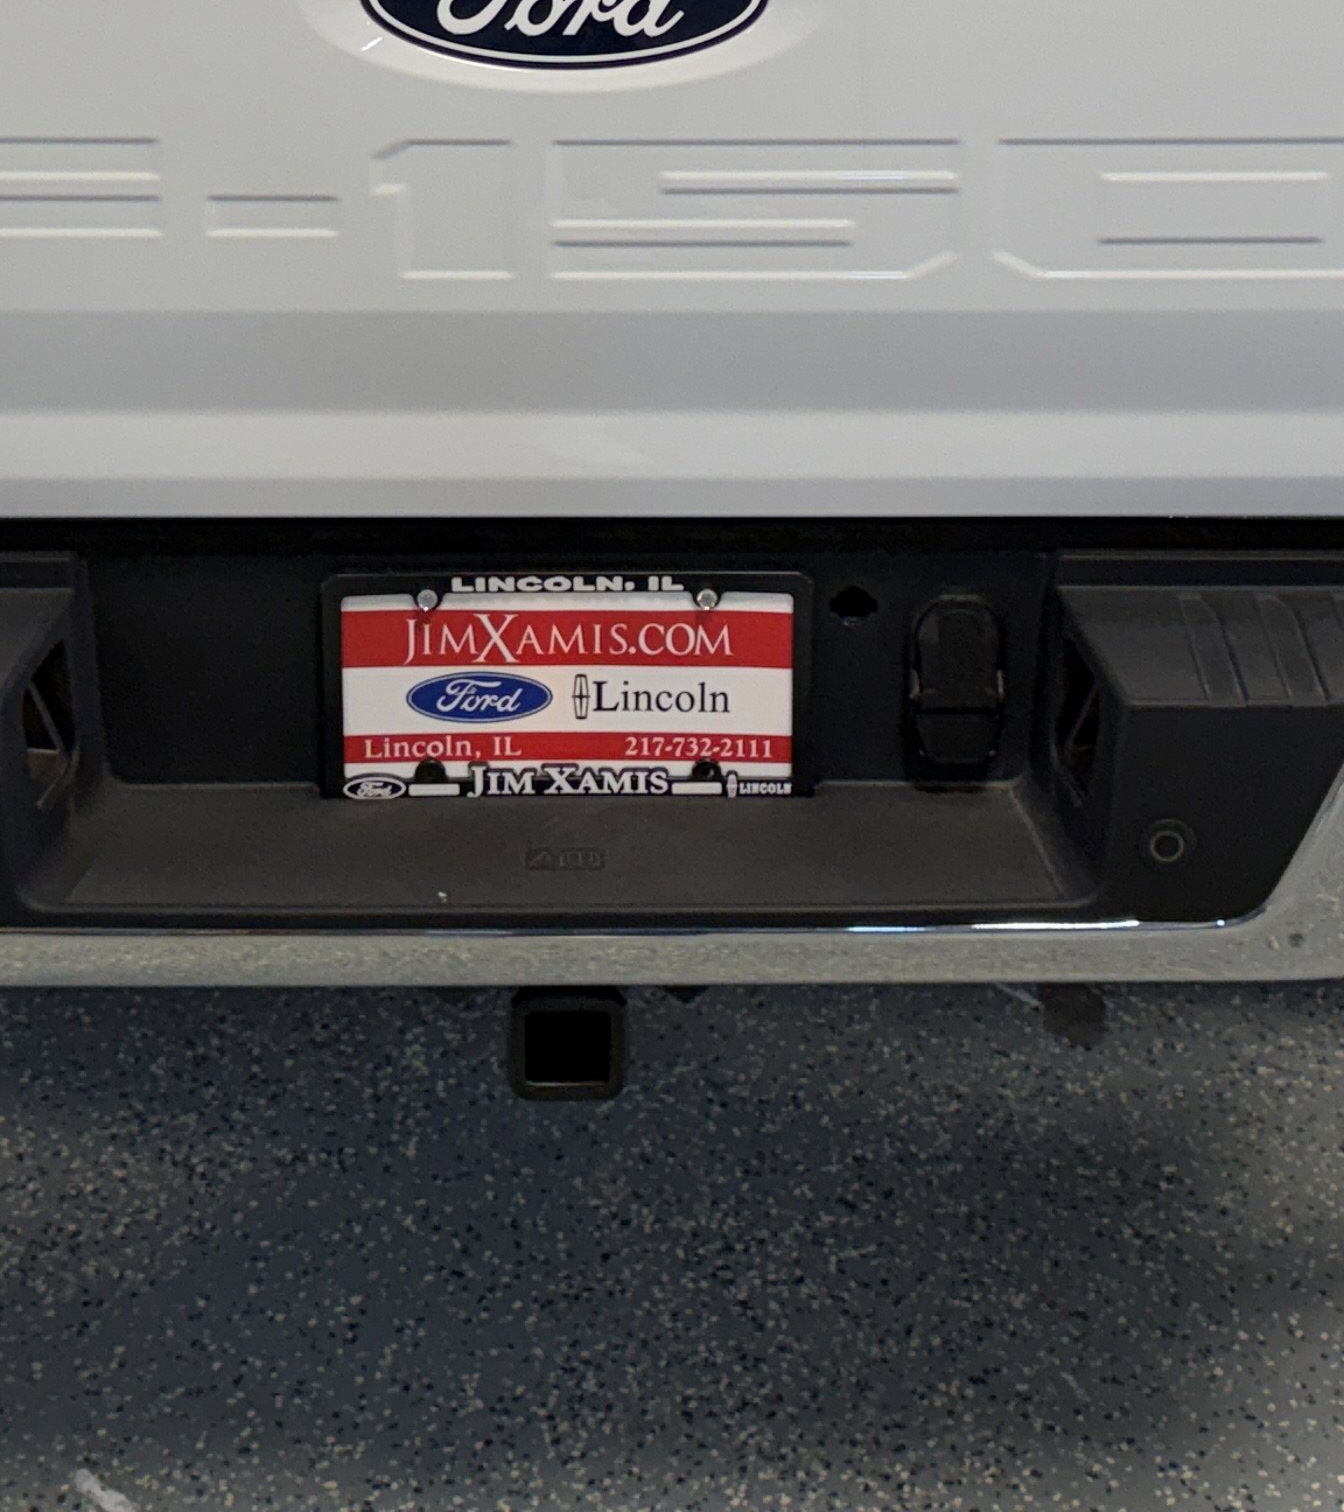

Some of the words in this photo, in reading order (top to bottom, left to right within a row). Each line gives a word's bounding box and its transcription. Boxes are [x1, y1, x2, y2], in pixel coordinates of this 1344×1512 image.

[450, 576, 636, 593] LINCOLN,
[647, 575, 685, 592] IL
[403, 613, 734, 665] JIMXAMIS.COM
[435, 678, 521, 715] Ford
[591, 680, 731, 714] Lincoln
[364, 735, 482, 760] Lincoln,
[493, 737, 523, 758] IL
[624, 736, 774, 759] 217-732-2111
[467, 765, 535, 798] JIM
[542, 767, 670, 796] XAMIS
[739, 782, 793, 795] LINCOLN
